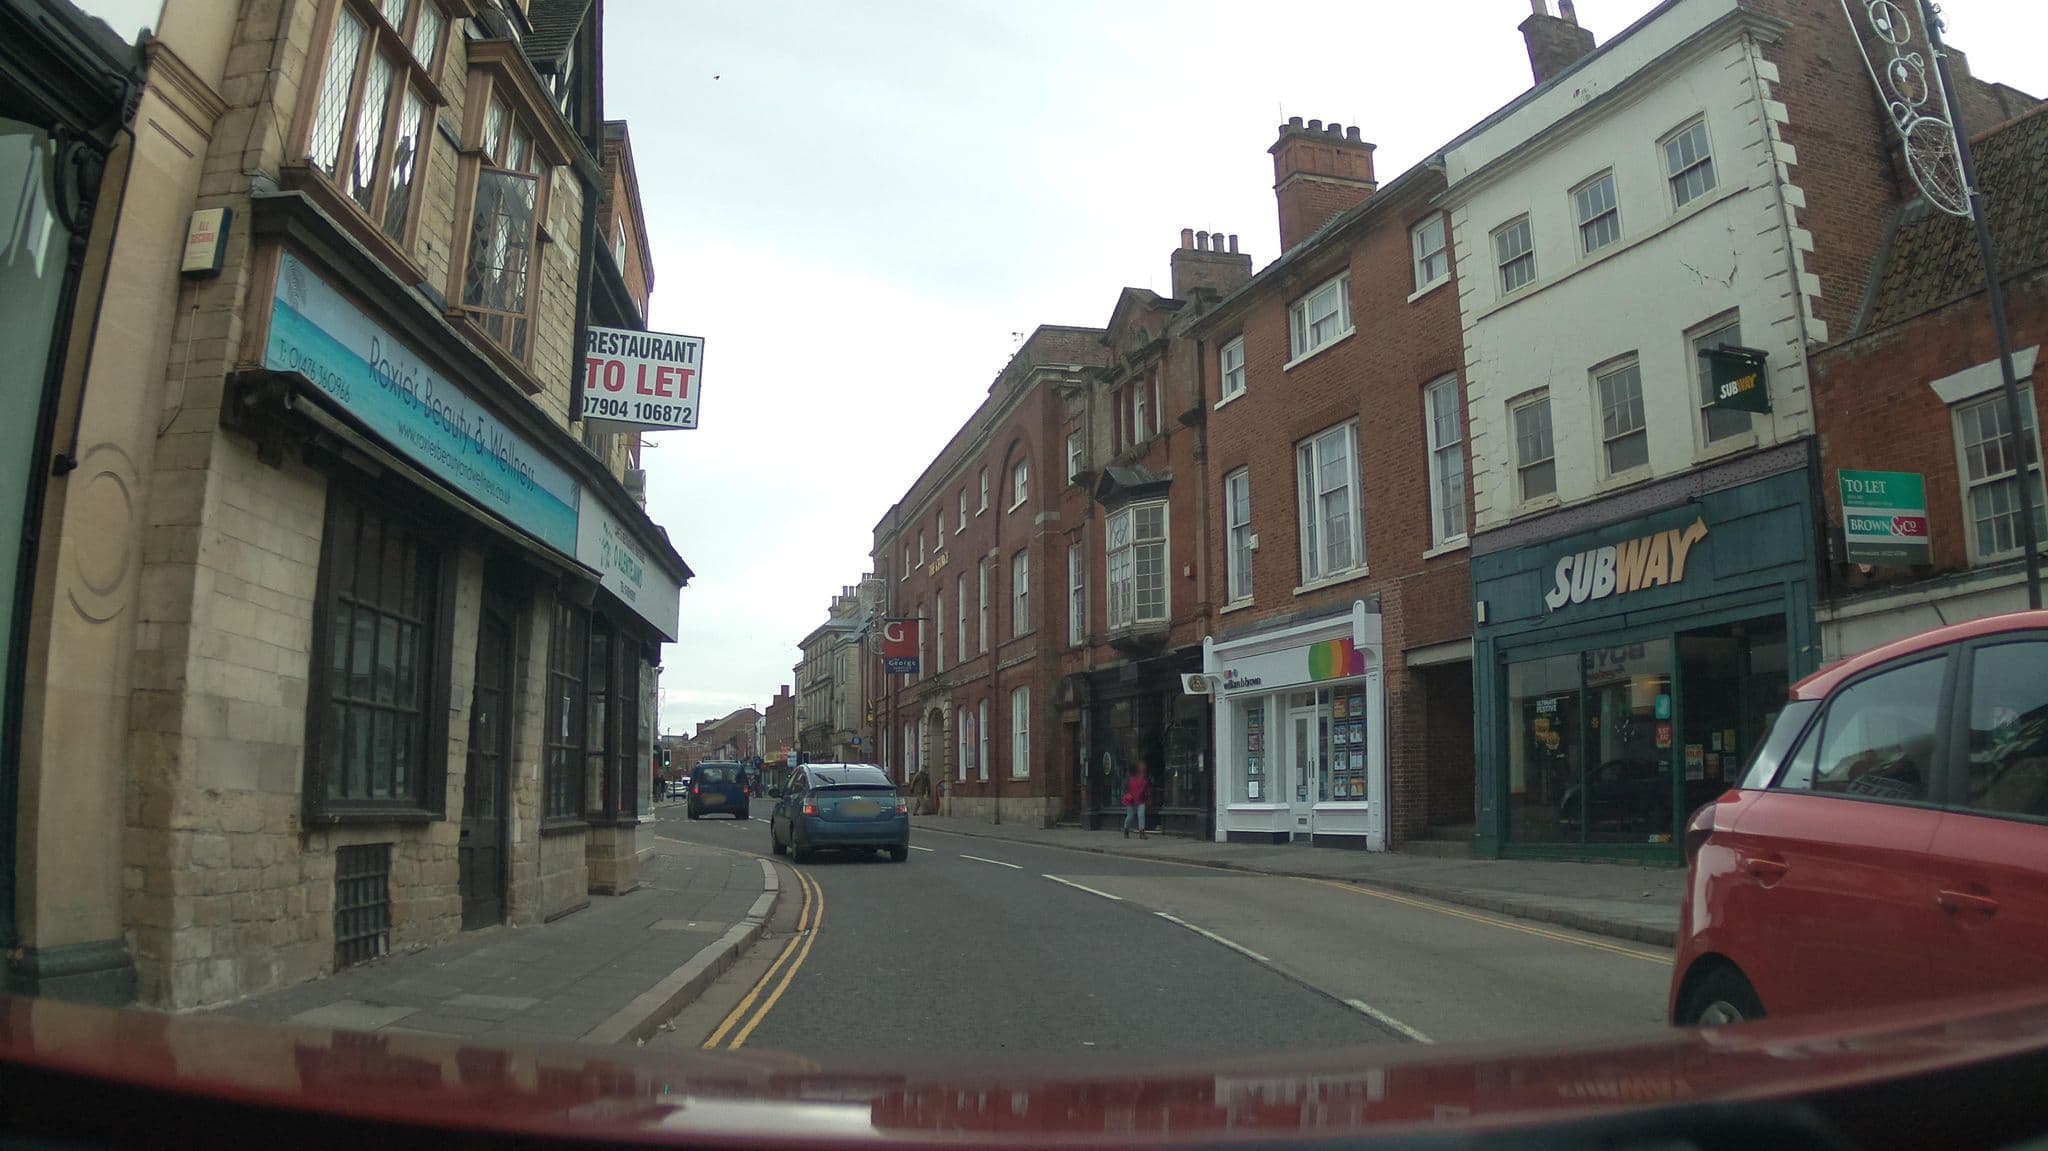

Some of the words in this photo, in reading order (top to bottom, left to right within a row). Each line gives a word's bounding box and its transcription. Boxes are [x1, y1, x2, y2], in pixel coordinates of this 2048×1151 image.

[587, 330, 697, 363] RESTAURANT
[289, 347, 316, 381] 01476
[585, 357, 626, 392] TO
[636, 363, 696, 399] LET
[1719, 373, 1758, 399] SUBWAY
[369, 335, 419, 410] Roxie's
[424, 377, 472, 454] Beauty
[474, 416, 486, 456] &
[490, 425, 535, 491] Wellness
[634, 402, 692, 423] 106872
[1845, 479, 1863, 492] TO
[1865, 480, 1887, 494] LET
[1850, 519, 1890, 532] BROWN
[1545, 516, 1708, 612] SUBWAY
[884, 621, 905, 642] G
